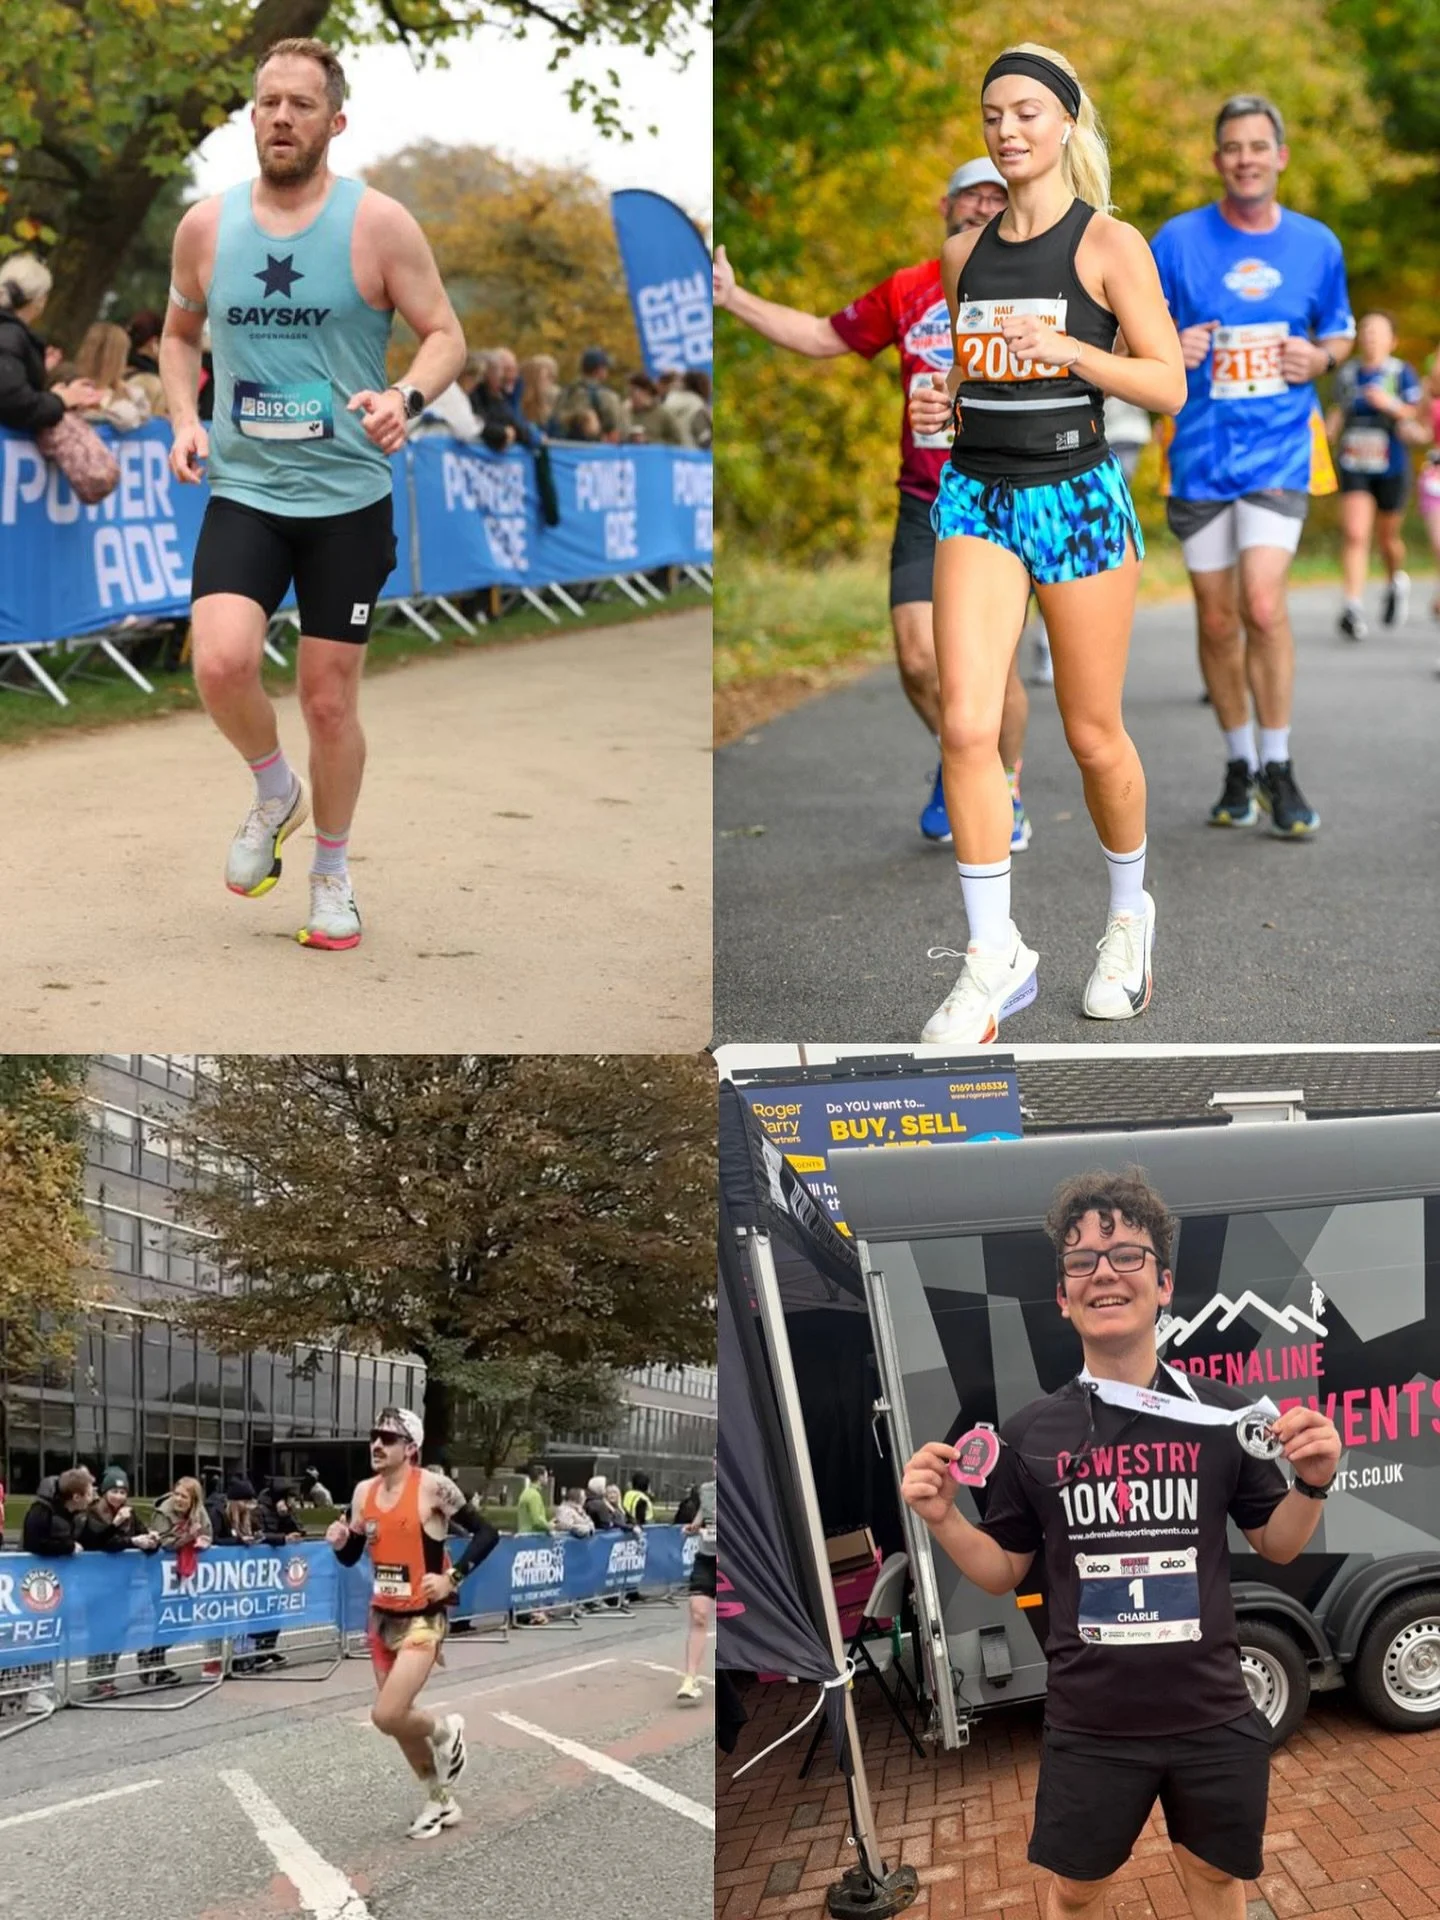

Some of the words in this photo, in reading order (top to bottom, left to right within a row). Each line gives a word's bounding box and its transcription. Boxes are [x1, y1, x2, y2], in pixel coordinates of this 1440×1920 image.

[227, 306, 331, 327] SAYSKY
[994, 305, 1015, 315] HALF
[248, 332, 309, 340] COPENHAGEN
[2, 439, 174, 525] POER
[94, 522, 192, 608] ADE
[752, 1103, 803, 1119] Roger
[826, 1103, 843, 1114] Do
[844, 1101, 870, 1112] YOU
[872, 1099, 902, 1111] want
[903, 1098, 925, 1109] to...
[830, 1117, 896, 1140] BUY,
[900, 1112, 967, 1135] SELL
[1058, 1481, 1120, 1527] 10K
[1129, 1478, 1199, 1522] RUN
[160, 1558, 284, 1598] ERDINGER
[1128, 1578, 1145, 1609] 1
[158, 1592, 306, 1625] ALKOHOLFREI
[1117, 1611, 1160, 1623] CHARLIE
